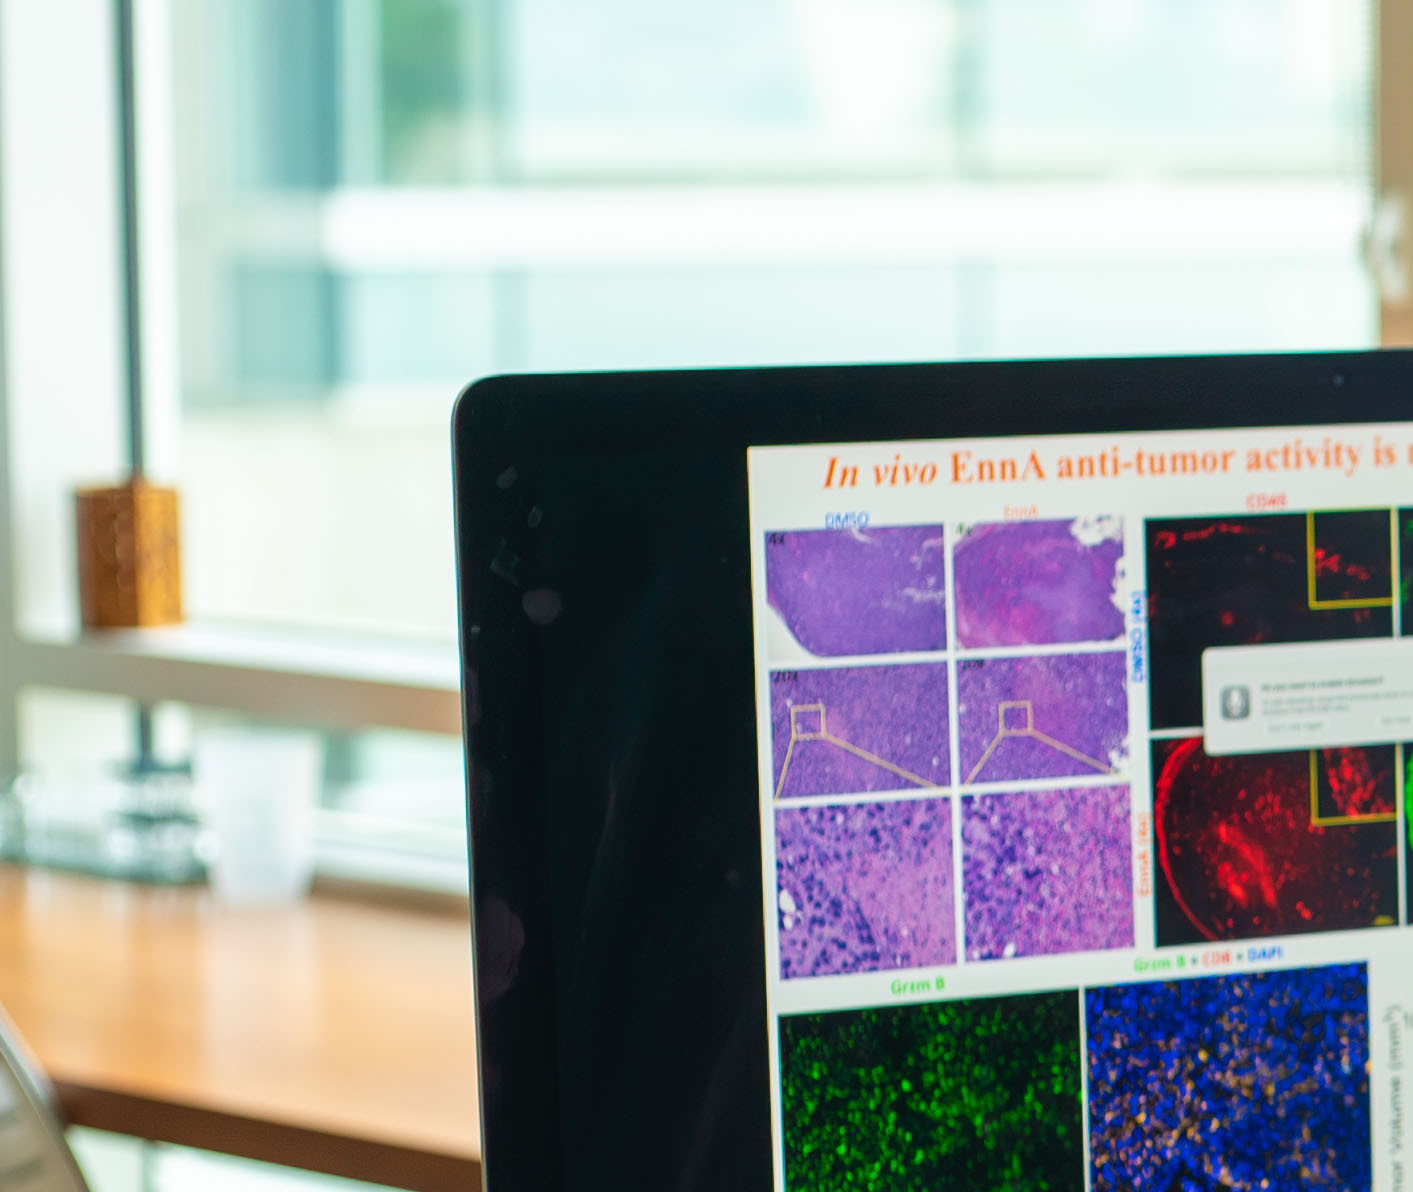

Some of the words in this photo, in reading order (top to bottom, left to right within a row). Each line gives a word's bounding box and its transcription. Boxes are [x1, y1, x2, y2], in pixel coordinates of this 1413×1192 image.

[823, 456, 859, 489] In
[874, 454, 937, 486] vivo
[951, 450, 1046, 483] EnnA
[1057, 445, 1236, 480] anti-tumor
[1246, 437, 1361, 477] activity
[1373, 433, 1397, 467] is
[825, 510, 870, 530] DMSO
[890, 978, 932, 995] Grzm
[935, 975, 945, 991] B
